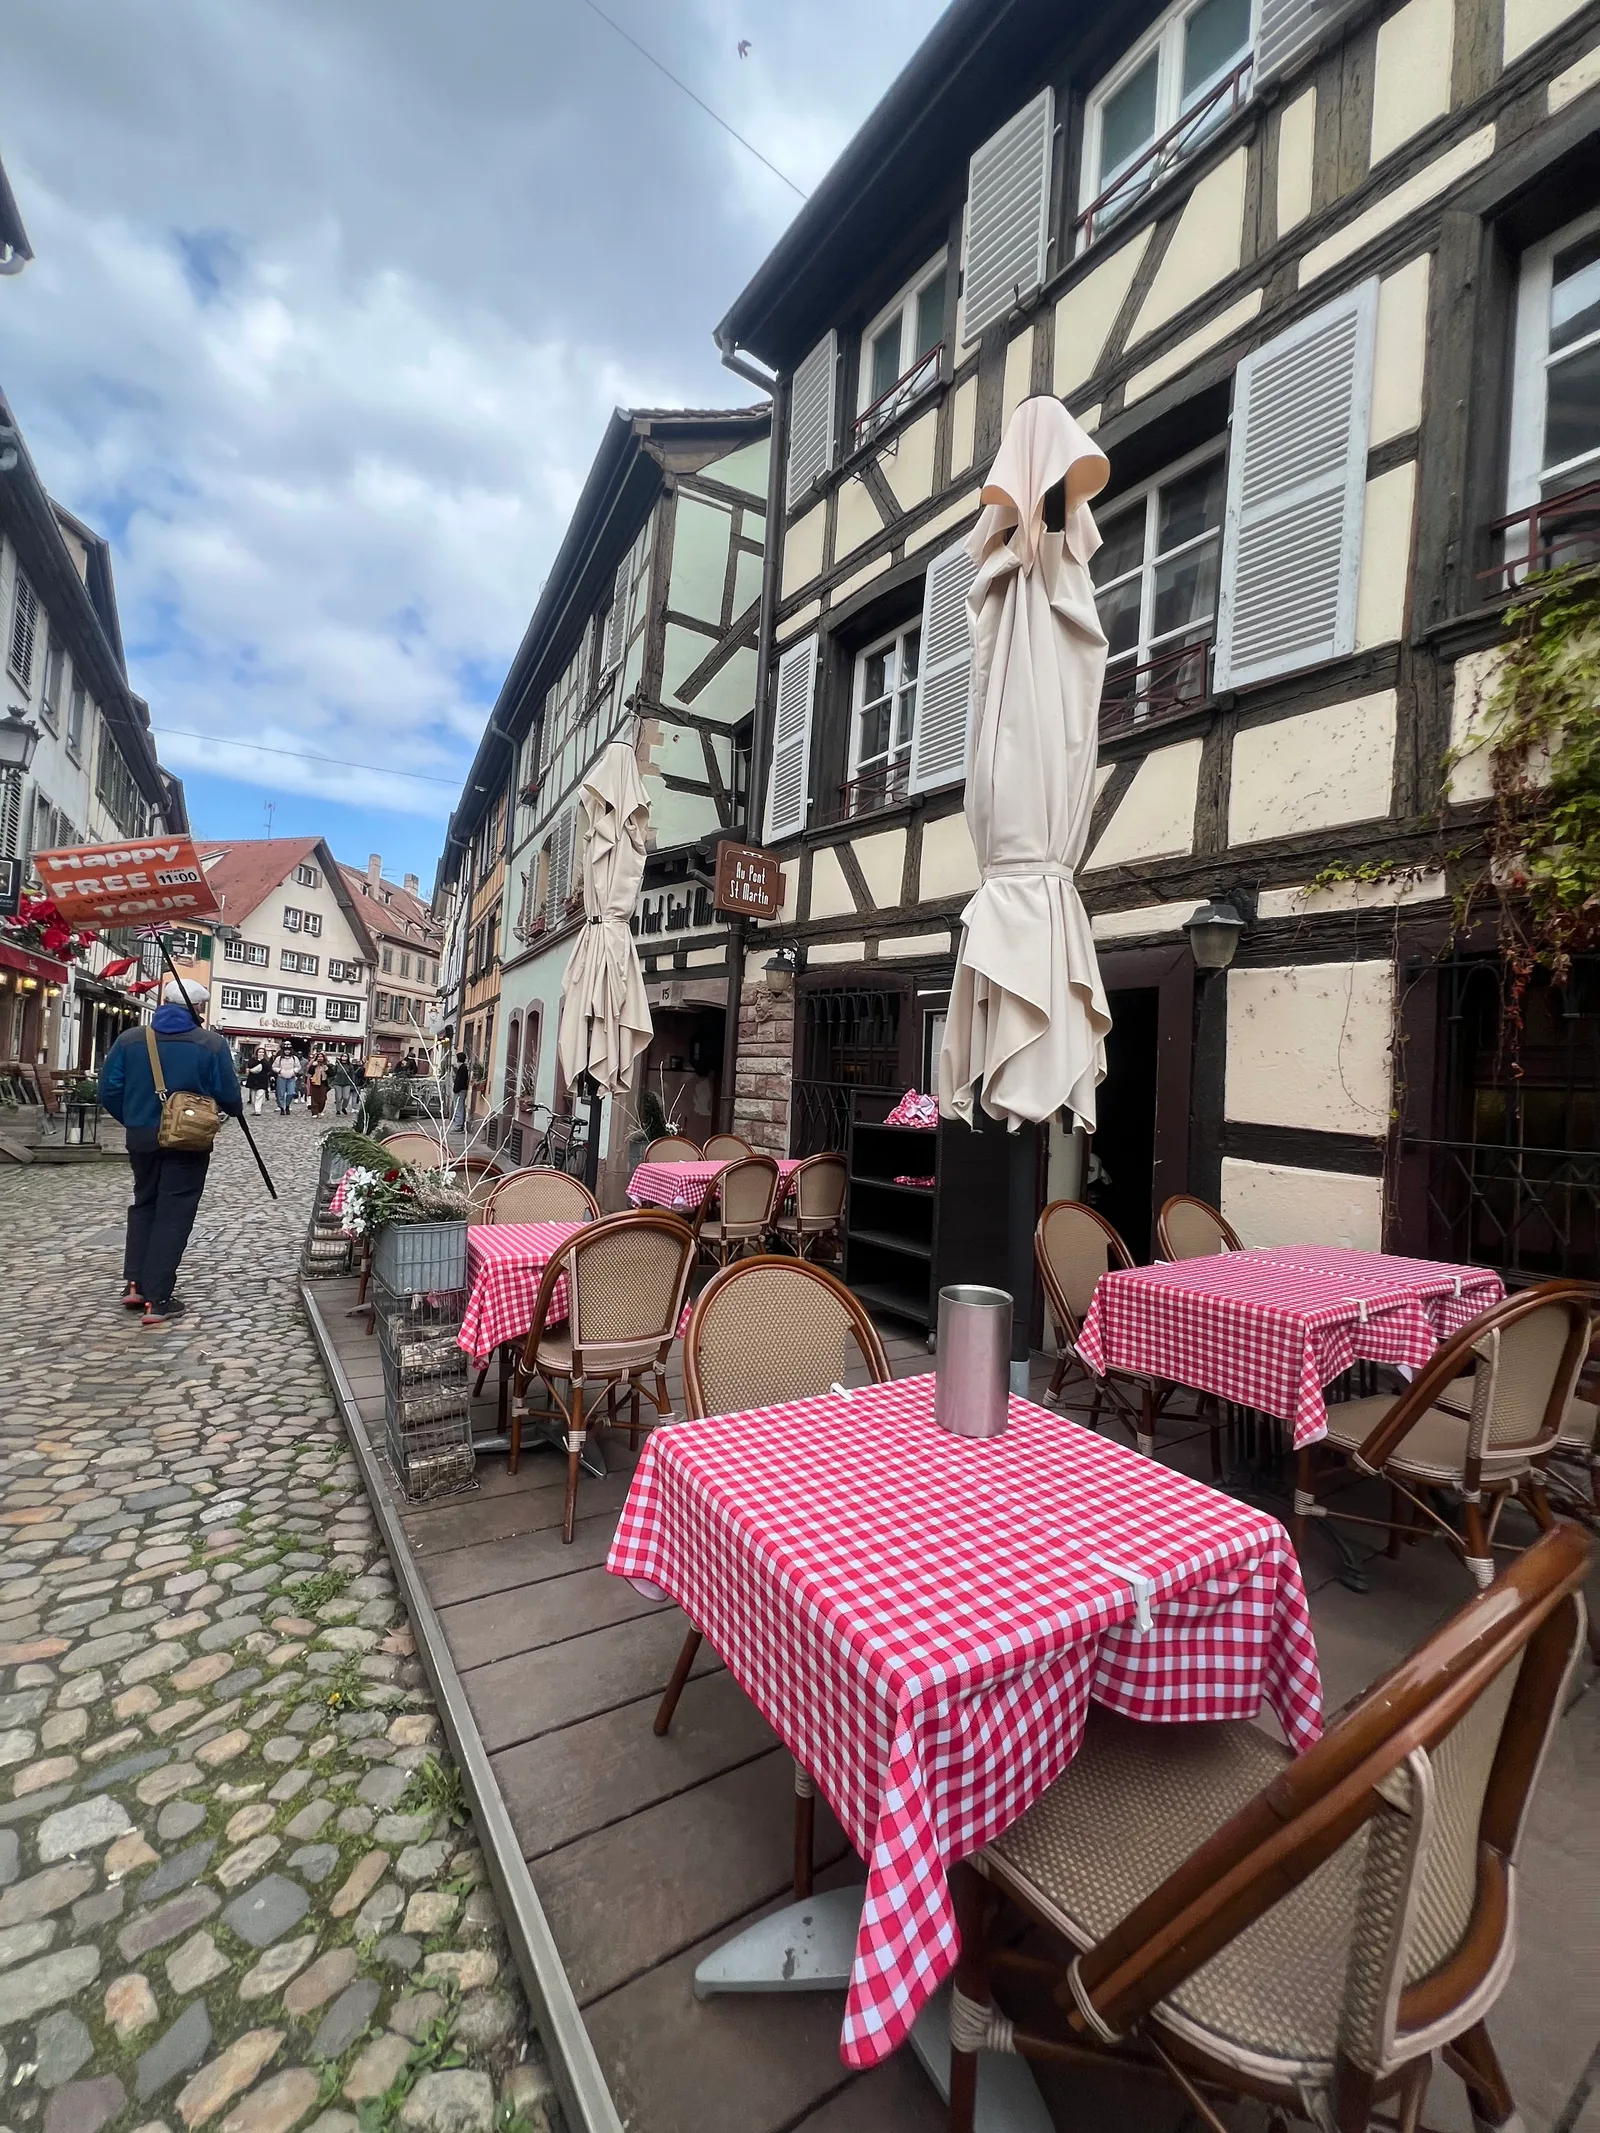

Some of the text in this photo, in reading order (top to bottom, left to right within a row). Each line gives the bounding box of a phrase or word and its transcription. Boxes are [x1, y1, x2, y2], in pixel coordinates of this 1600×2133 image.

[48, 845, 179, 871] Happy
[52, 872, 151, 898] FREE
[158, 871, 197, 885] 11:00
[736, 861, 765, 885] Au Pont
[730, 880, 769, 905] St Martin
[94, 894, 198, 918] TOUR
[662, 987, 670, 1000] 15
